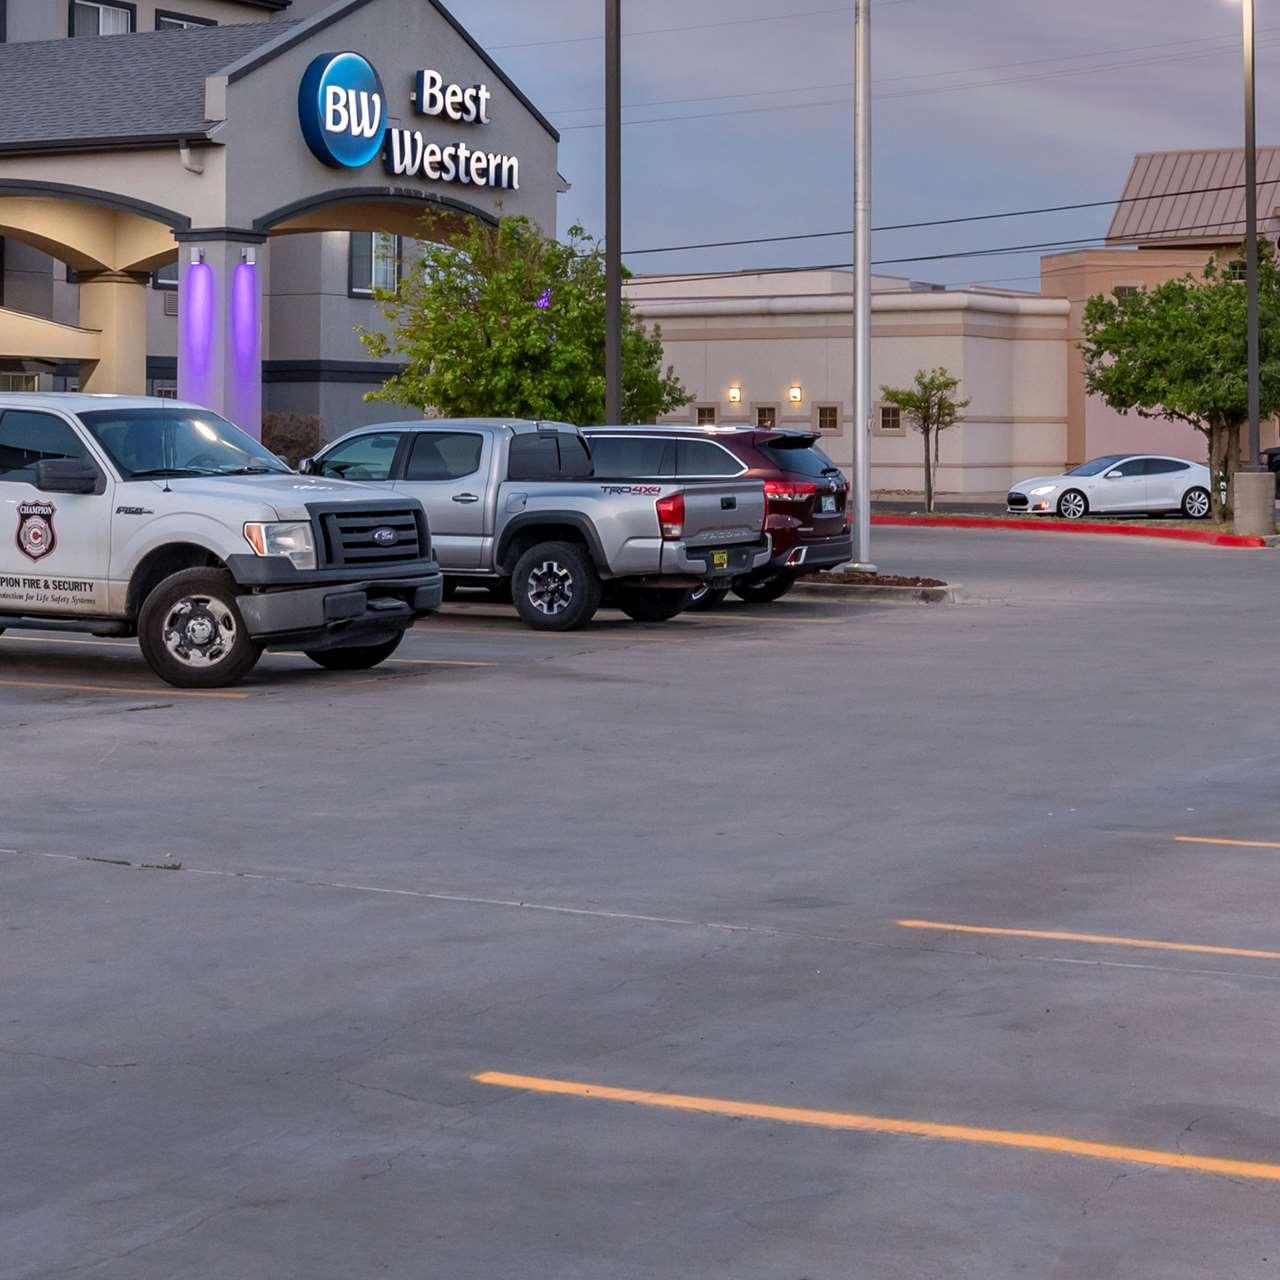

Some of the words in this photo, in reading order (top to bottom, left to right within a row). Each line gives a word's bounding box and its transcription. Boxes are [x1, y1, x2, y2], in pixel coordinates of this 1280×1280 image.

[326, 85, 380, 137] BW
[423, 69, 490, 124] Best
[392, 128, 519, 189] Western
[20, 505, 52, 515] CHAMPION
[23, 578, 40, 589] FIRE
[43, 580, 50, 590] &
[52, 580, 94, 592] SECURITY
[25, 593, 35, 602] for
[36, 593, 50, 604] Life
[51, 594, 70, 606] Safety
